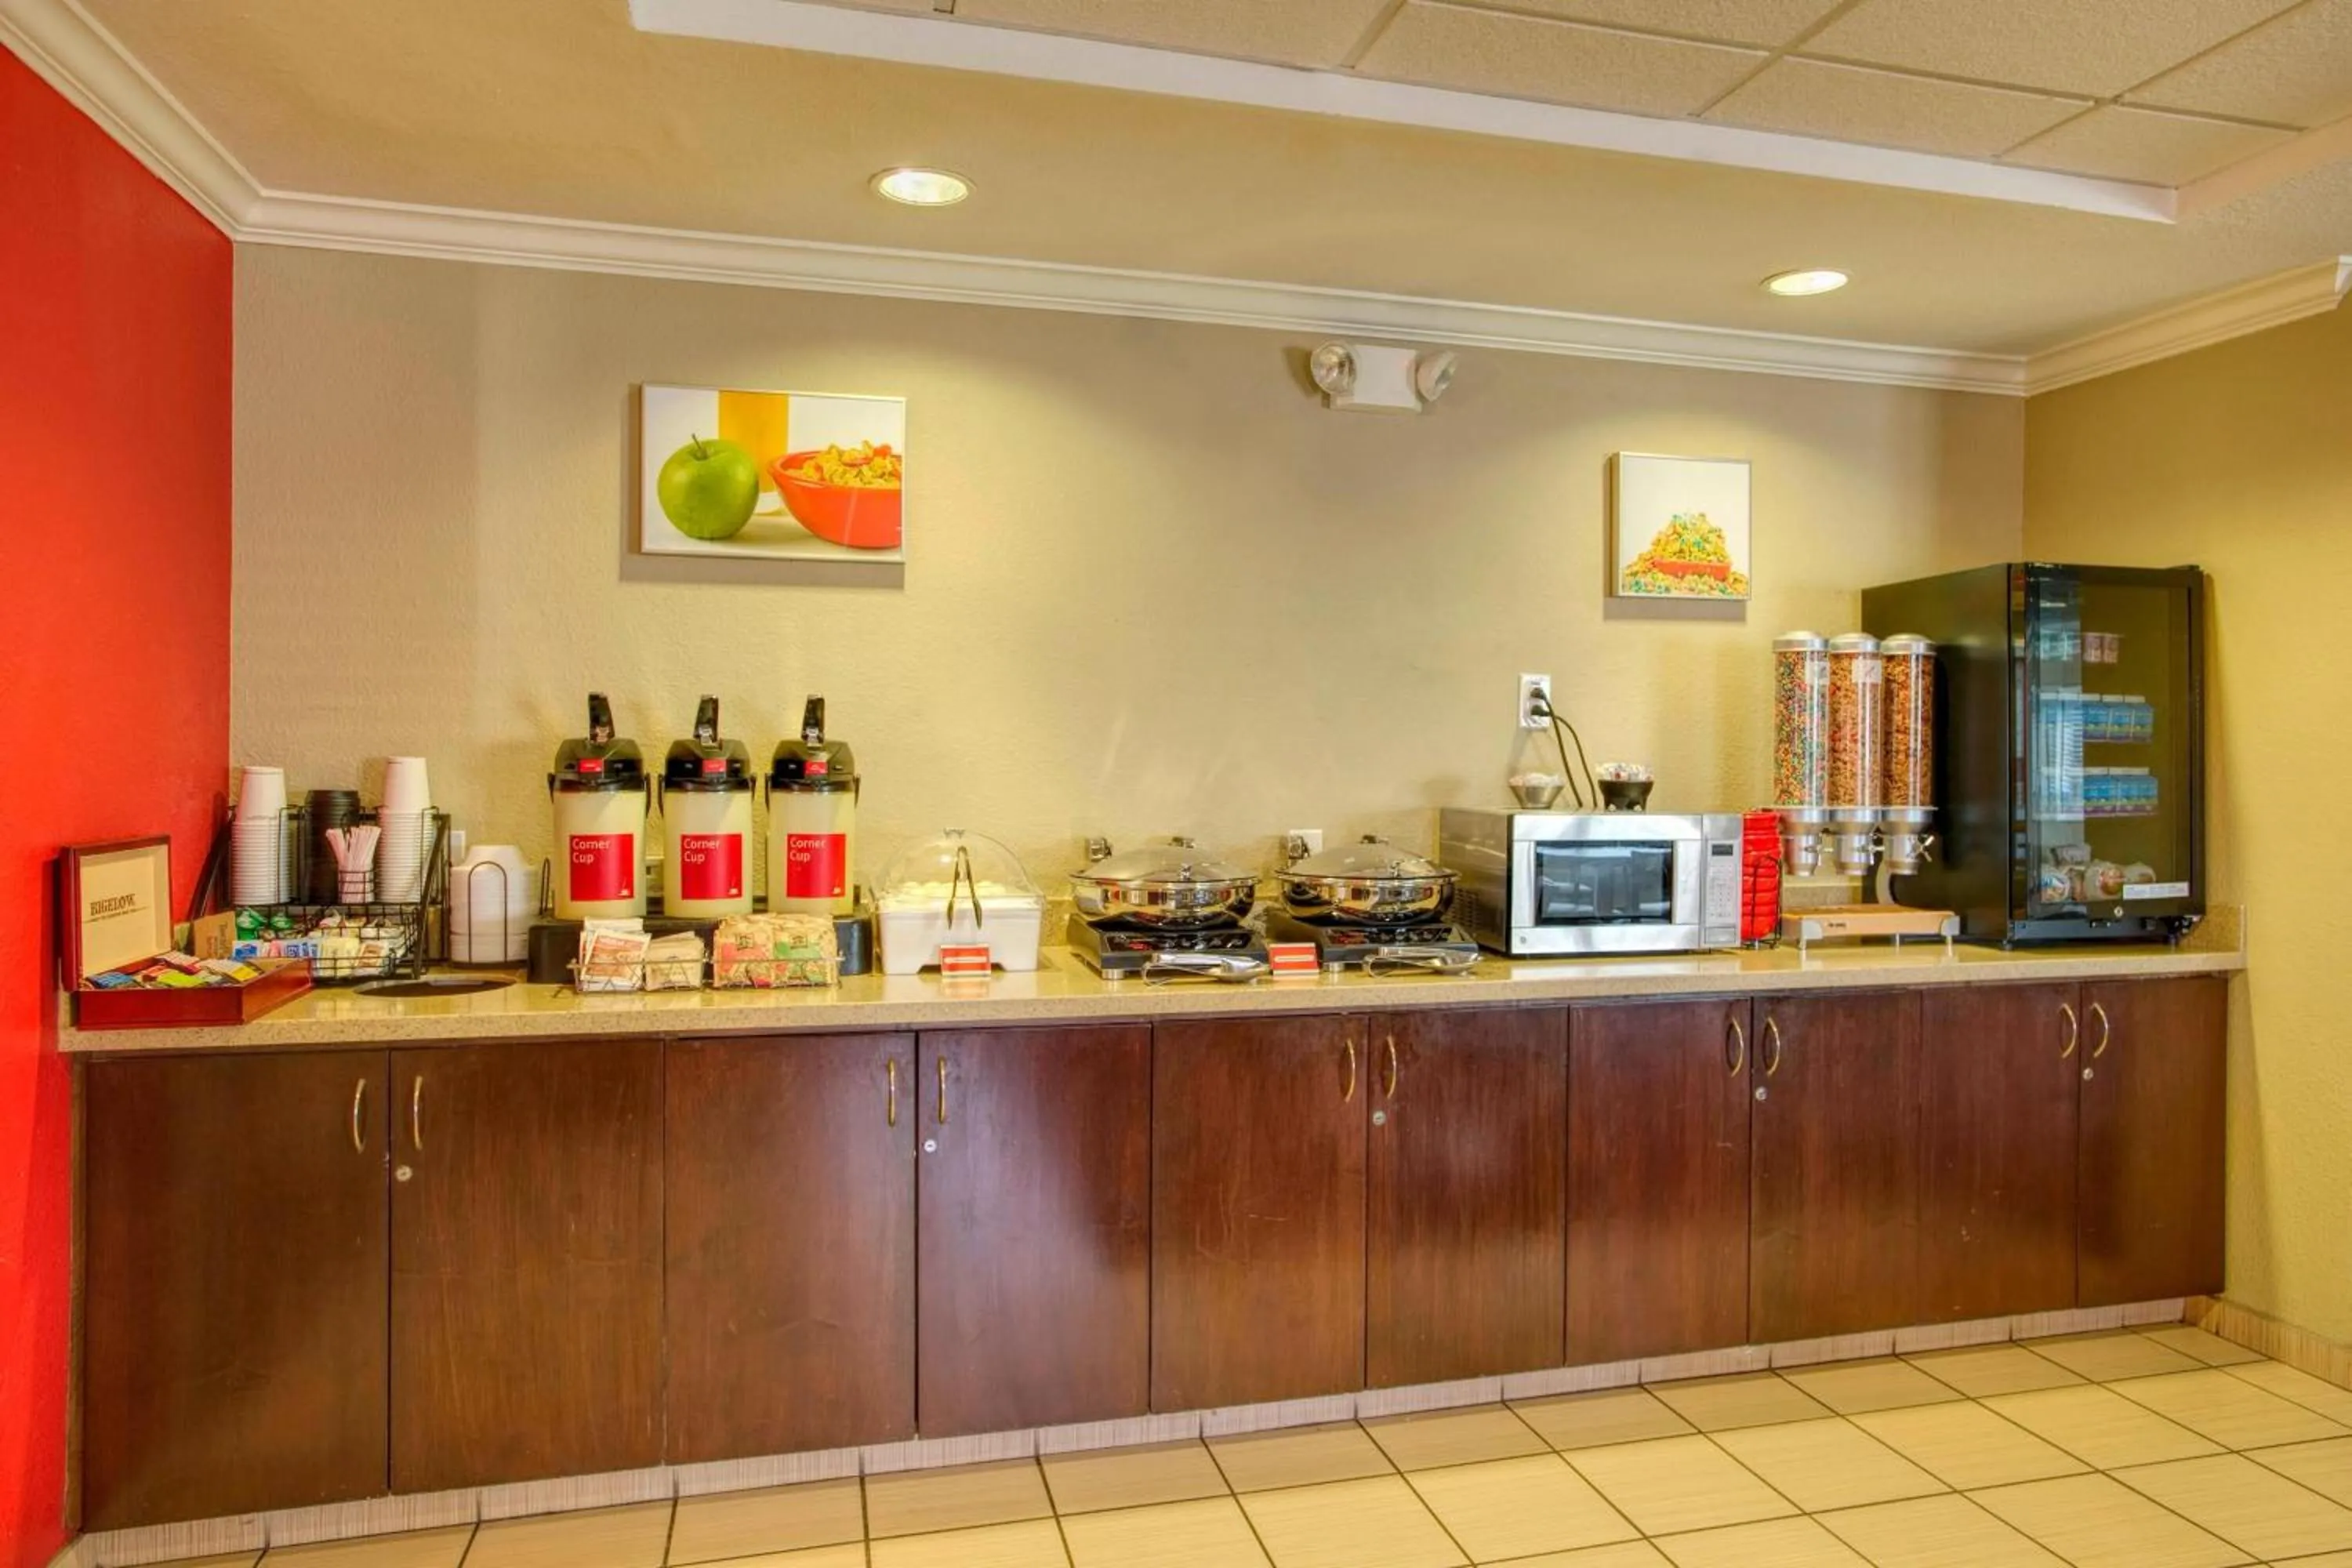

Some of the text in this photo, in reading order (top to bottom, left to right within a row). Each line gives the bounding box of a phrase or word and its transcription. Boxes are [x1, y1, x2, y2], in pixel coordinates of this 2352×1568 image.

[572, 838, 610, 850] Corner
[684, 838, 720, 850] Corner
[790, 837, 826, 848] Corner
[572, 851, 593, 865] Cup
[684, 851, 705, 865] Cup
[790, 850, 811, 863] Cup
[90, 893, 136, 916] BIGELOW
